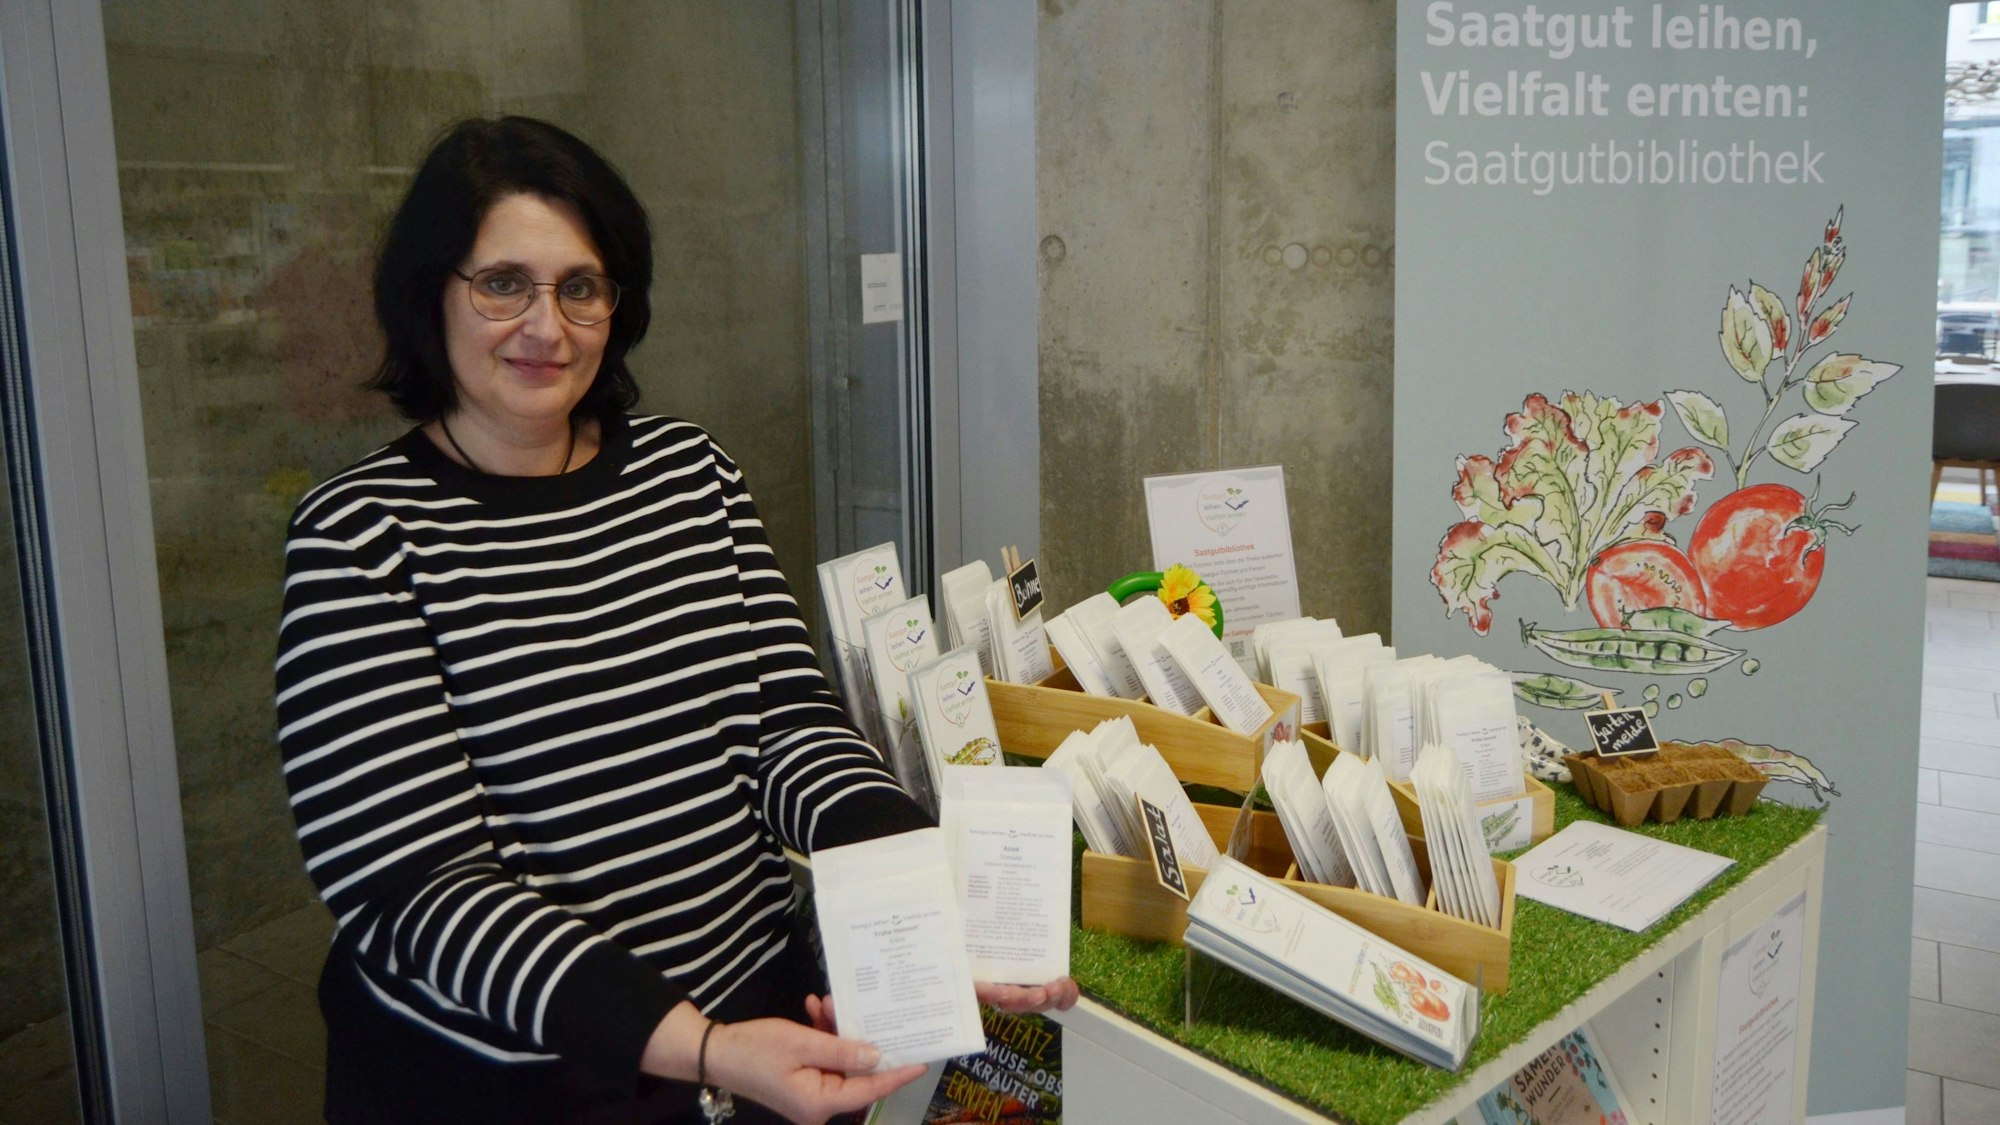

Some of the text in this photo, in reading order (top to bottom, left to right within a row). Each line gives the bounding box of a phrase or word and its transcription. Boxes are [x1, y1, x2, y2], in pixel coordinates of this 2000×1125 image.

[1426, 1, 1818, 60] Saatgut leihen,
[1420, 70, 1809, 118] Vielfalt ernten:
[1424, 139, 1826, 197] Saatgutbibliothek
[1193, 543, 1256, 557] Saatgutbibliothek
[1611, 718, 1647, 752] melde
[1146, 805, 1182, 886] Salat
[946, 1070, 1003, 1125] ERNTEN
[971, 1057, 1039, 1110] KRÄUTER
[1525, 1055, 1566, 1106] WUNDER
